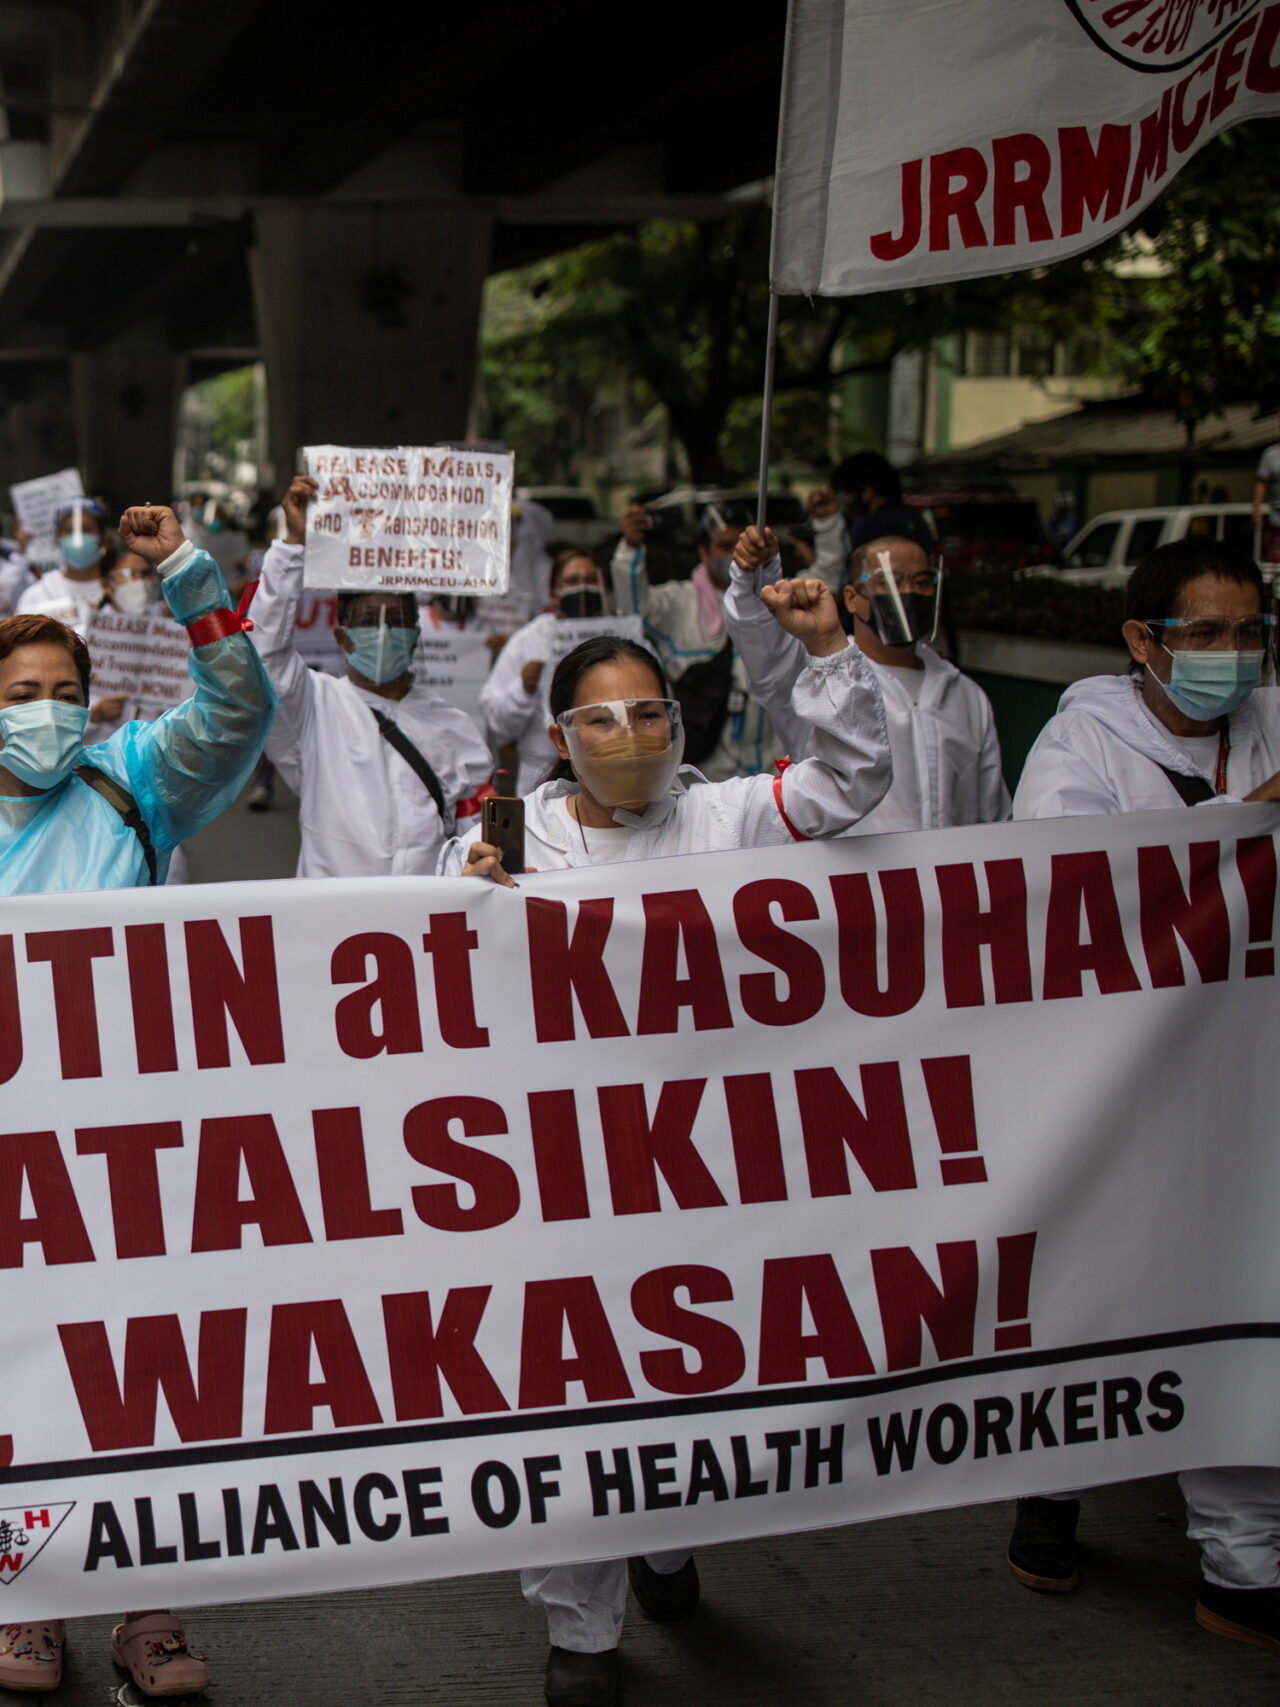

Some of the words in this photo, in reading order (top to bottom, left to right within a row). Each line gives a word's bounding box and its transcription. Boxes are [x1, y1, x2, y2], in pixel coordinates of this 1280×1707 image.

[329, 911, 491, 1060] at
[524, 834, 1277, 1044] KASUHAN!
[56, 1231, 1038, 1453] WAKASAN!
[82, 1466, 450, 1572] ALLIANCE
[470, 1454, 563, 1529] OF
[584, 1422, 845, 1518] HEALTH
[866, 1369, 1186, 1478] WORKERS
